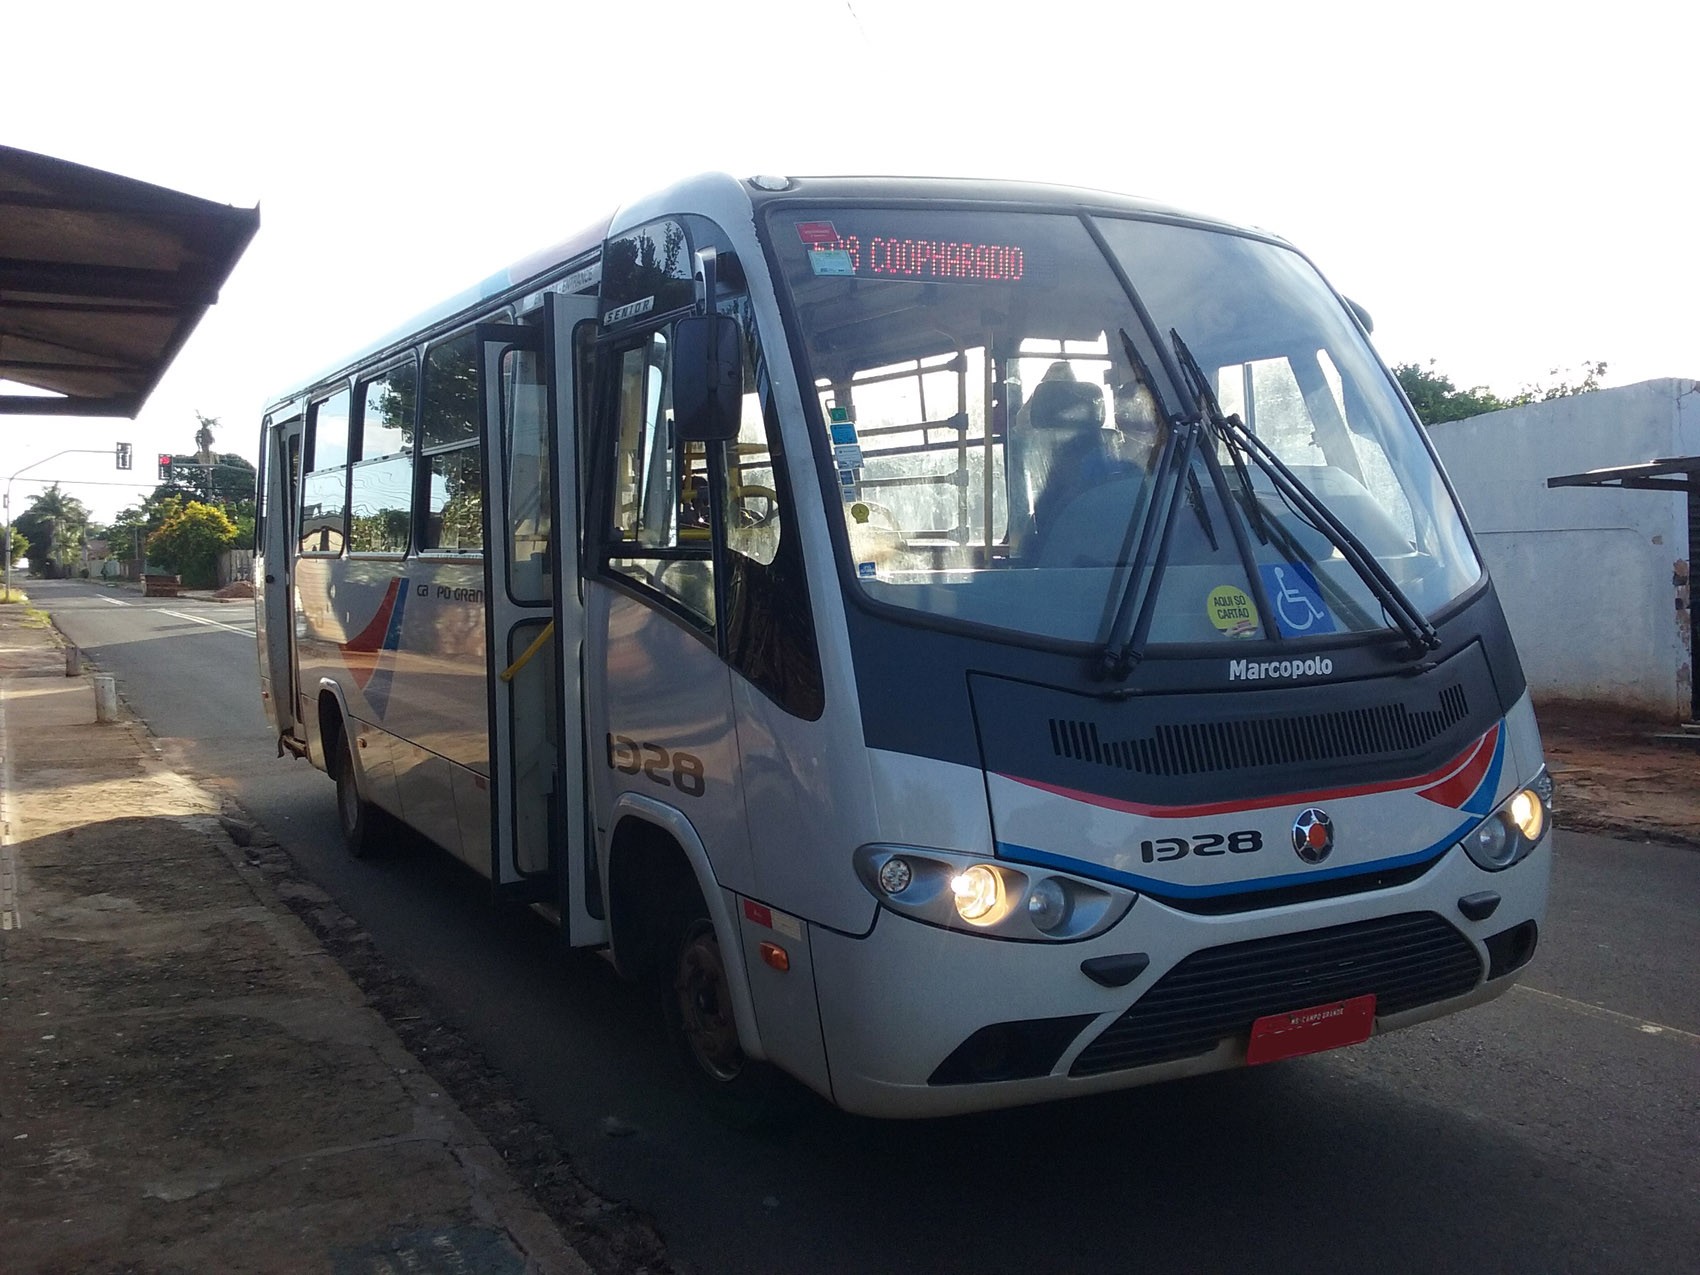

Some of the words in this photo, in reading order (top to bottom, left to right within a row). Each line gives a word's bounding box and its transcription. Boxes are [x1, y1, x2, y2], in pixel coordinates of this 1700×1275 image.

[606, 301, 650, 322] SENIOR
[1213, 596, 1234, 606] AQUI
[1229, 656, 1333, 681] Marcopolo
